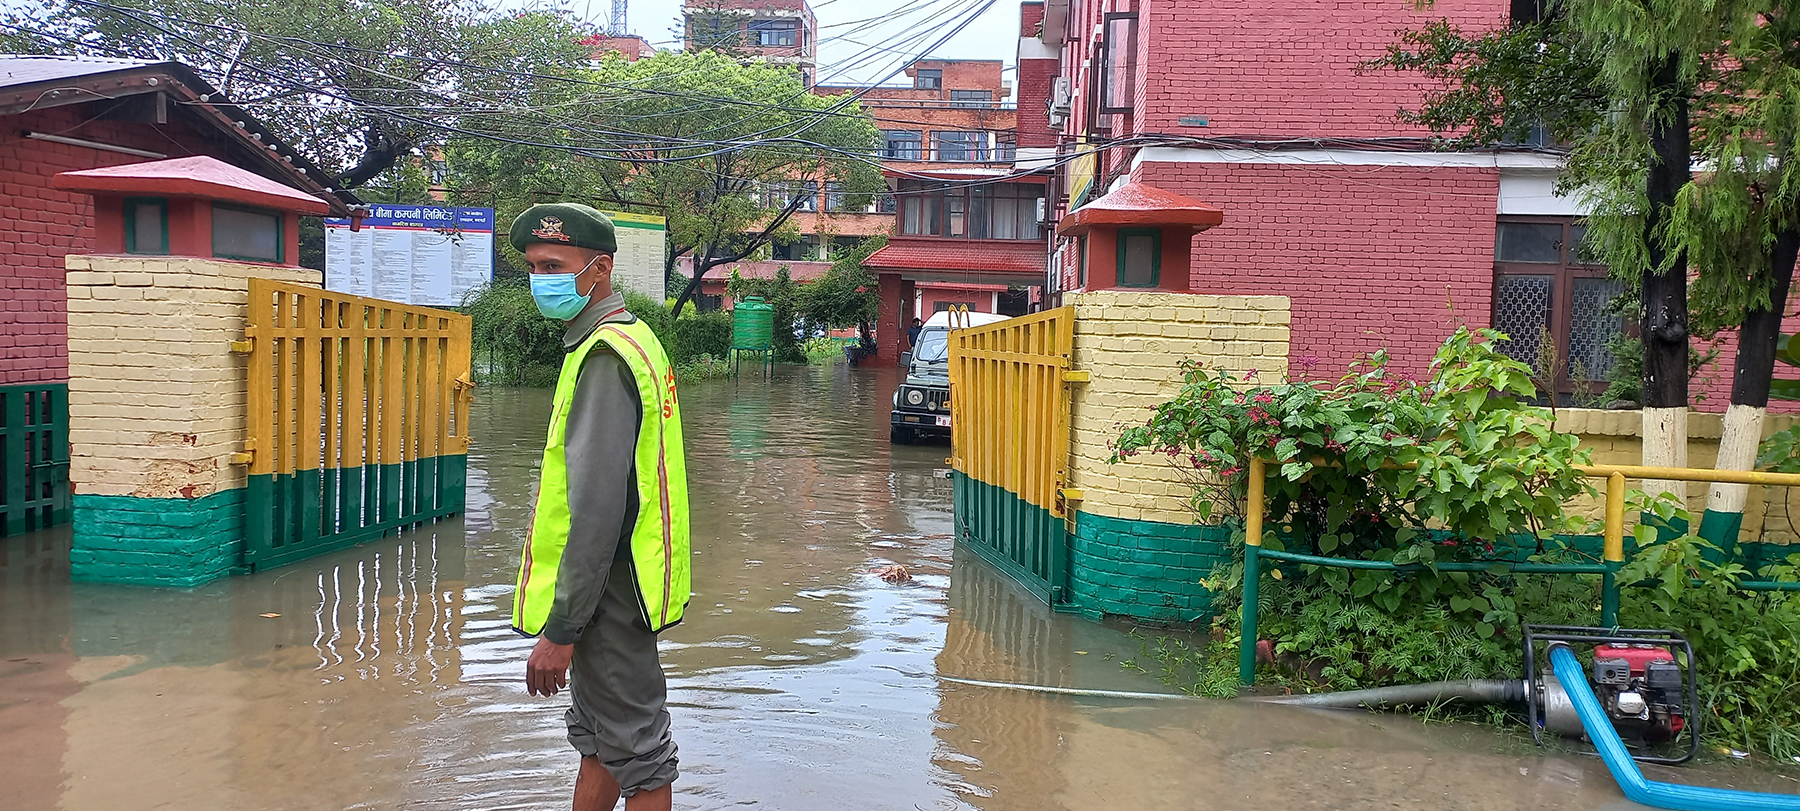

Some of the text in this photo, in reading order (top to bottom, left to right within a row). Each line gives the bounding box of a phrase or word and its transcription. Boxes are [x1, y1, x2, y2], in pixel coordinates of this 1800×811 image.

[376, 206, 393, 218] बीमा
[394, 208, 421, 219] कम्पनी
[423, 207, 453, 220] लिमिटेड
